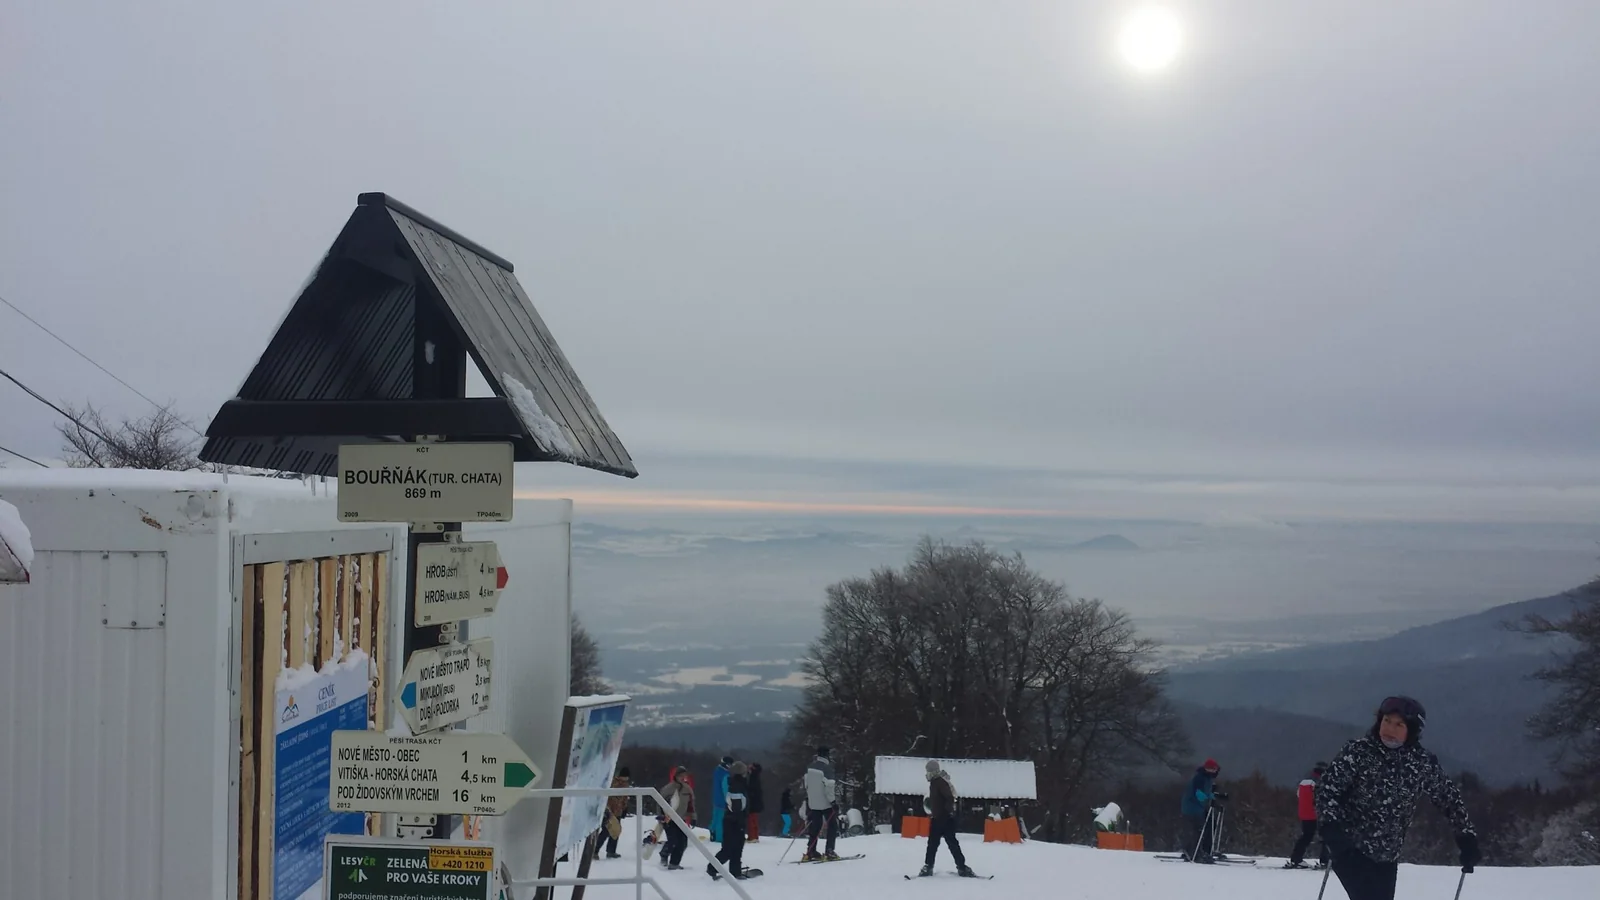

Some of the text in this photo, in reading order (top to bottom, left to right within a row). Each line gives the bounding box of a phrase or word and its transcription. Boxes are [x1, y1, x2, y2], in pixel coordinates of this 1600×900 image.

[344, 466, 502, 486] BOUŘŇÁK (TUR. CHATA)
[405, 488, 441, 498] 869 m
[426, 566, 446, 578] HROB
[480, 563, 484, 574] 4
[424, 590, 444, 604] HROB
[478, 586, 486, 598] 4,5
[420, 664, 434, 681] NOVÉ
[436, 661, 453, 677] MĚSTO
[471, 692, 478, 706] 12
[338, 746, 360, 762] NOVÉ
[362, 746, 390, 762] MĚSTO
[397, 750, 420, 762] OBEC
[462, 750, 468, 764] 1
[482, 755, 497, 764] km
[338, 764, 368, 780] VITIŠKA
[375, 766, 409, 781] HORSKÁ
[411, 768, 438, 782] CHATA
[460, 770, 478, 784] 4,5
[481, 774, 496, 784] km
[338, 784, 496, 803] POD ŽIDOVSKÝM VRCHEM 16 km
[430, 848, 492, 857] Horská služba
[387, 857, 428, 869] ZELENÁ
[442, 860, 484, 869] +420 1210
[386, 871, 480, 886] PRO VAŠE KROKY
